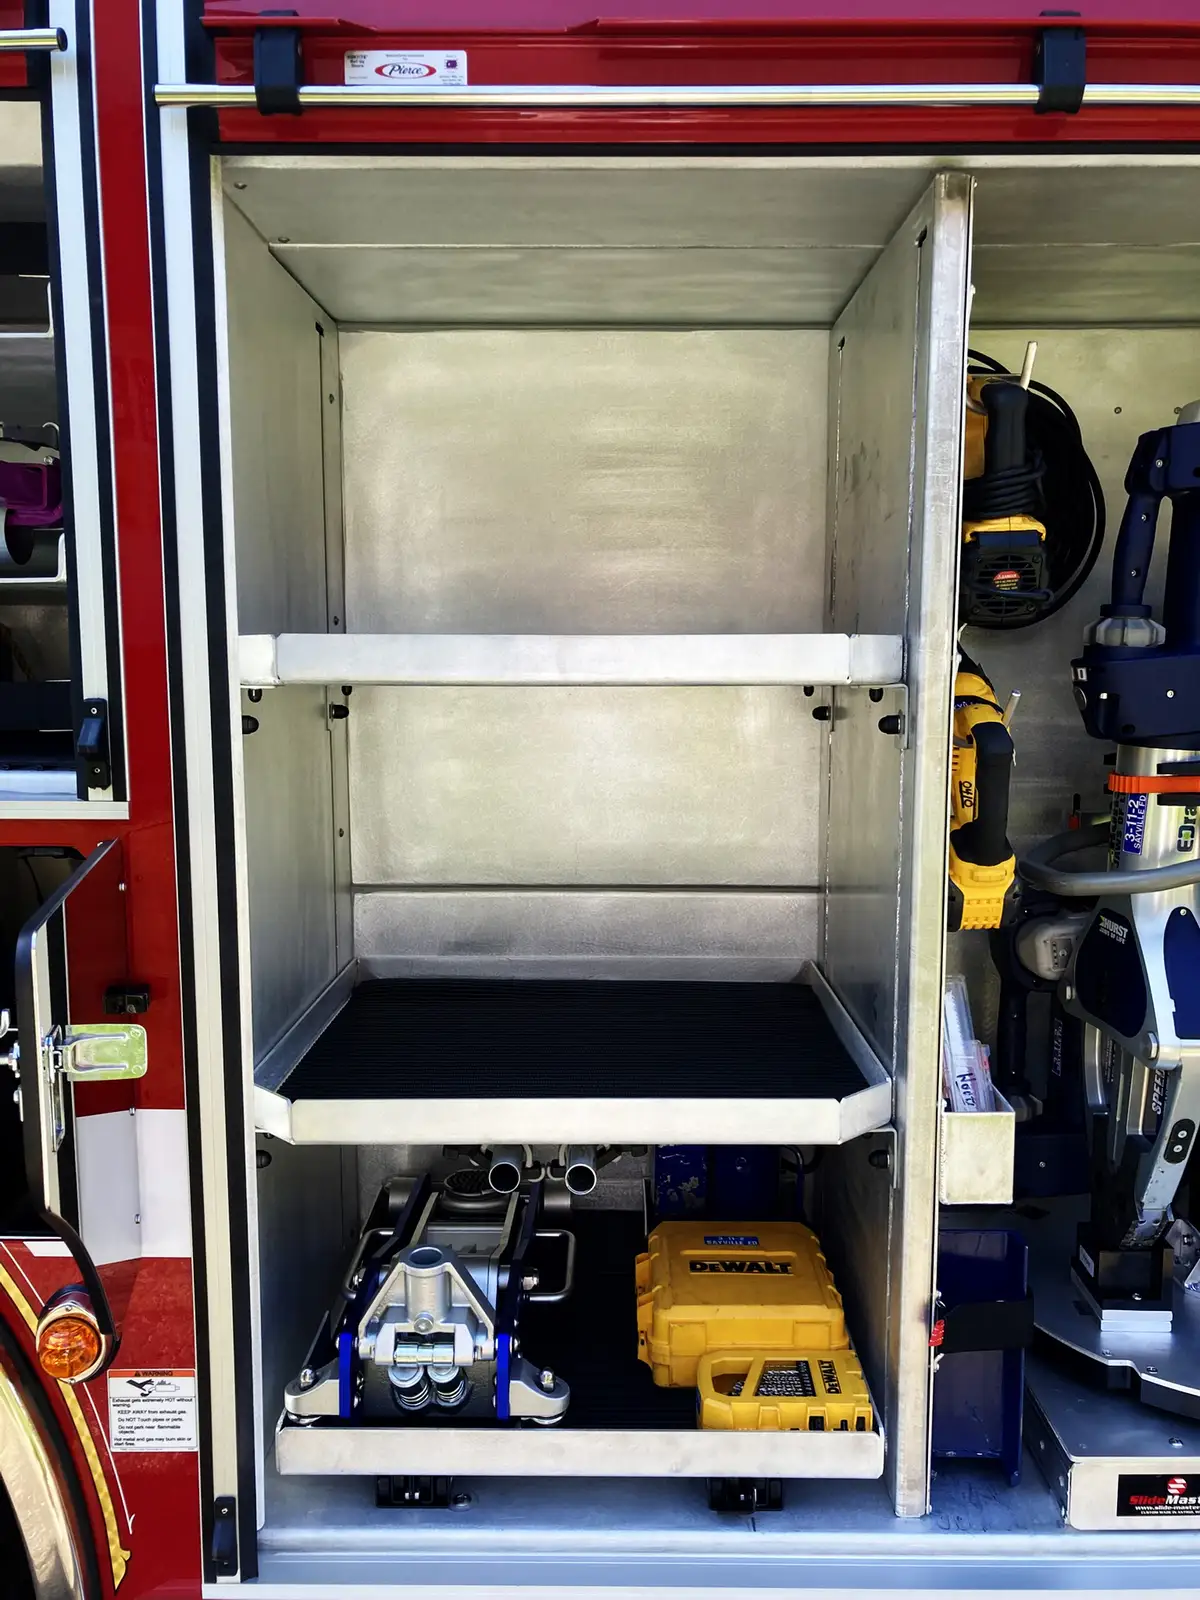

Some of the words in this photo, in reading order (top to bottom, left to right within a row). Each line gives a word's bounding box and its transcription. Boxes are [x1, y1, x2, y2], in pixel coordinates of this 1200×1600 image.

[388, 64, 422, 75] Pierce
[1124, 799, 1140, 842] 3-11-2
[1133, 808, 1145, 849] SAYVILLE
[1104, 917, 1128, 938] HURST
[690, 1260, 792, 1273] DEWALT
[820, 1360, 841, 1394] DEWALT
